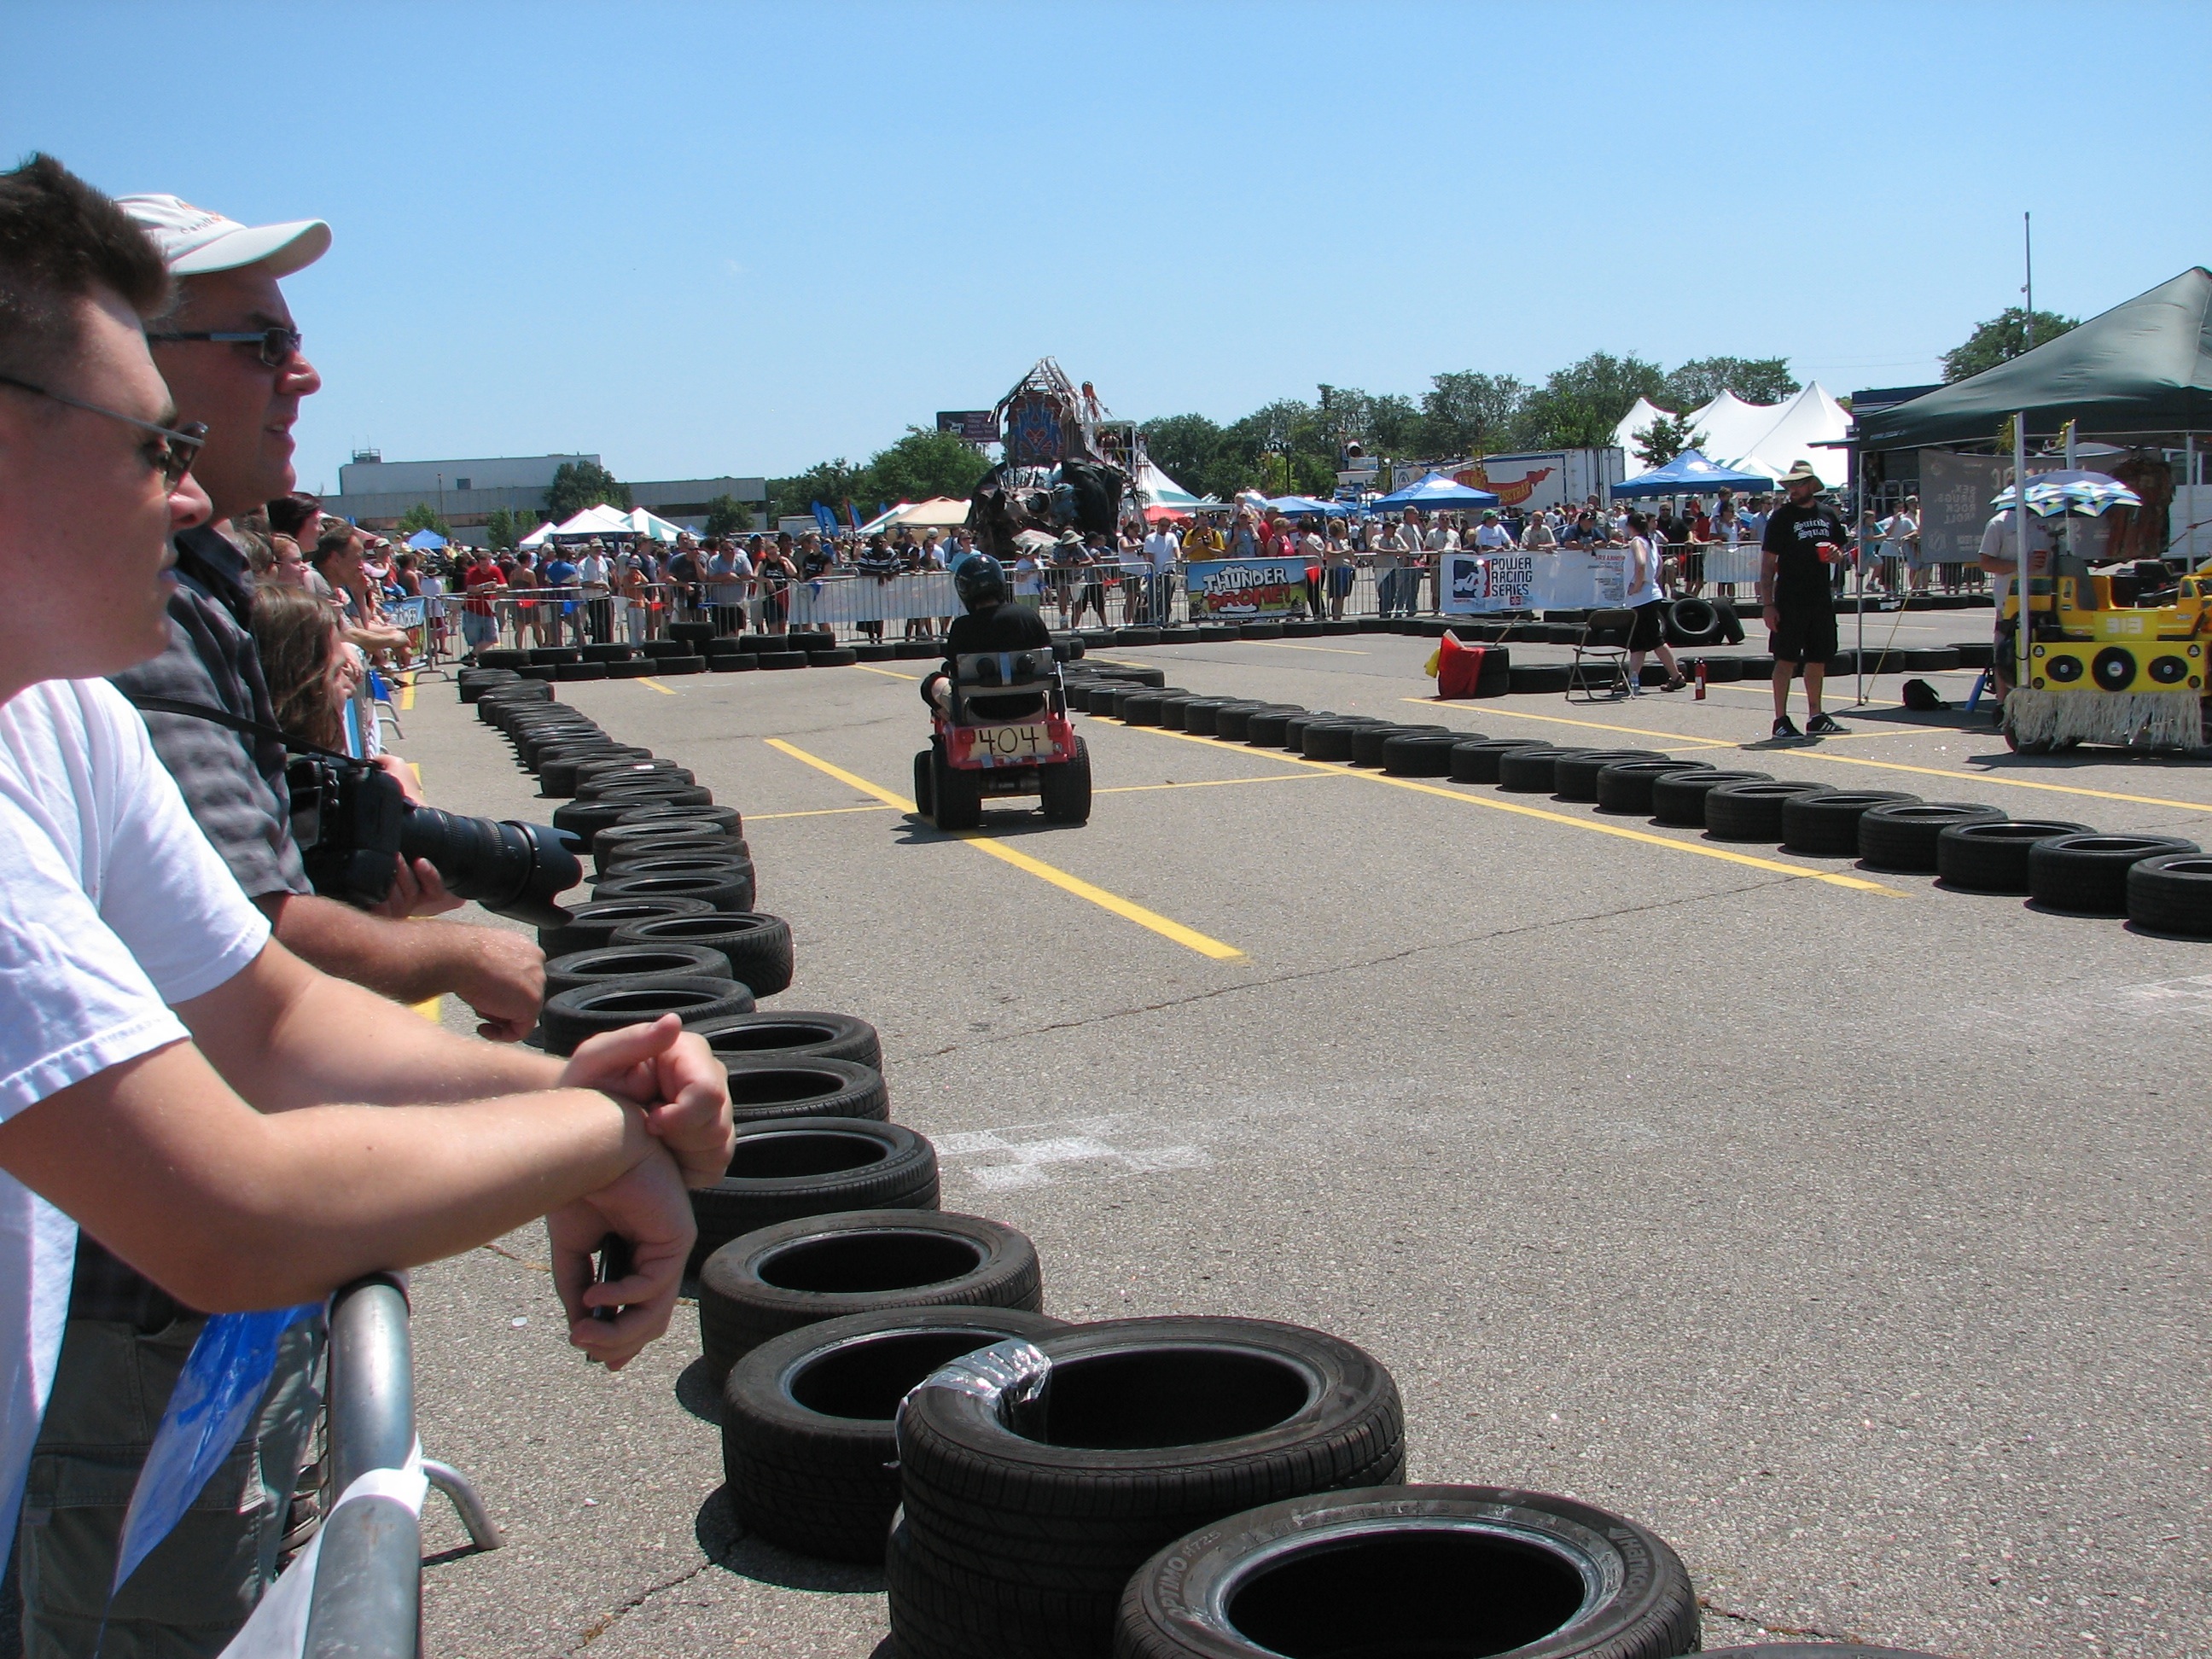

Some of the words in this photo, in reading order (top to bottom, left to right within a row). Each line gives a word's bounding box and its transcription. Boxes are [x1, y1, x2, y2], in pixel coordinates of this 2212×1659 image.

[1491, 557, 1532, 570] POWER
[1203, 568, 1288, 591] THUNDER
[1491, 570, 1533, 584] RACING
[1207, 585, 1291, 610] DROME!
[1491, 583, 1529, 597] SERIES
[978, 725, 1040, 755] 404
